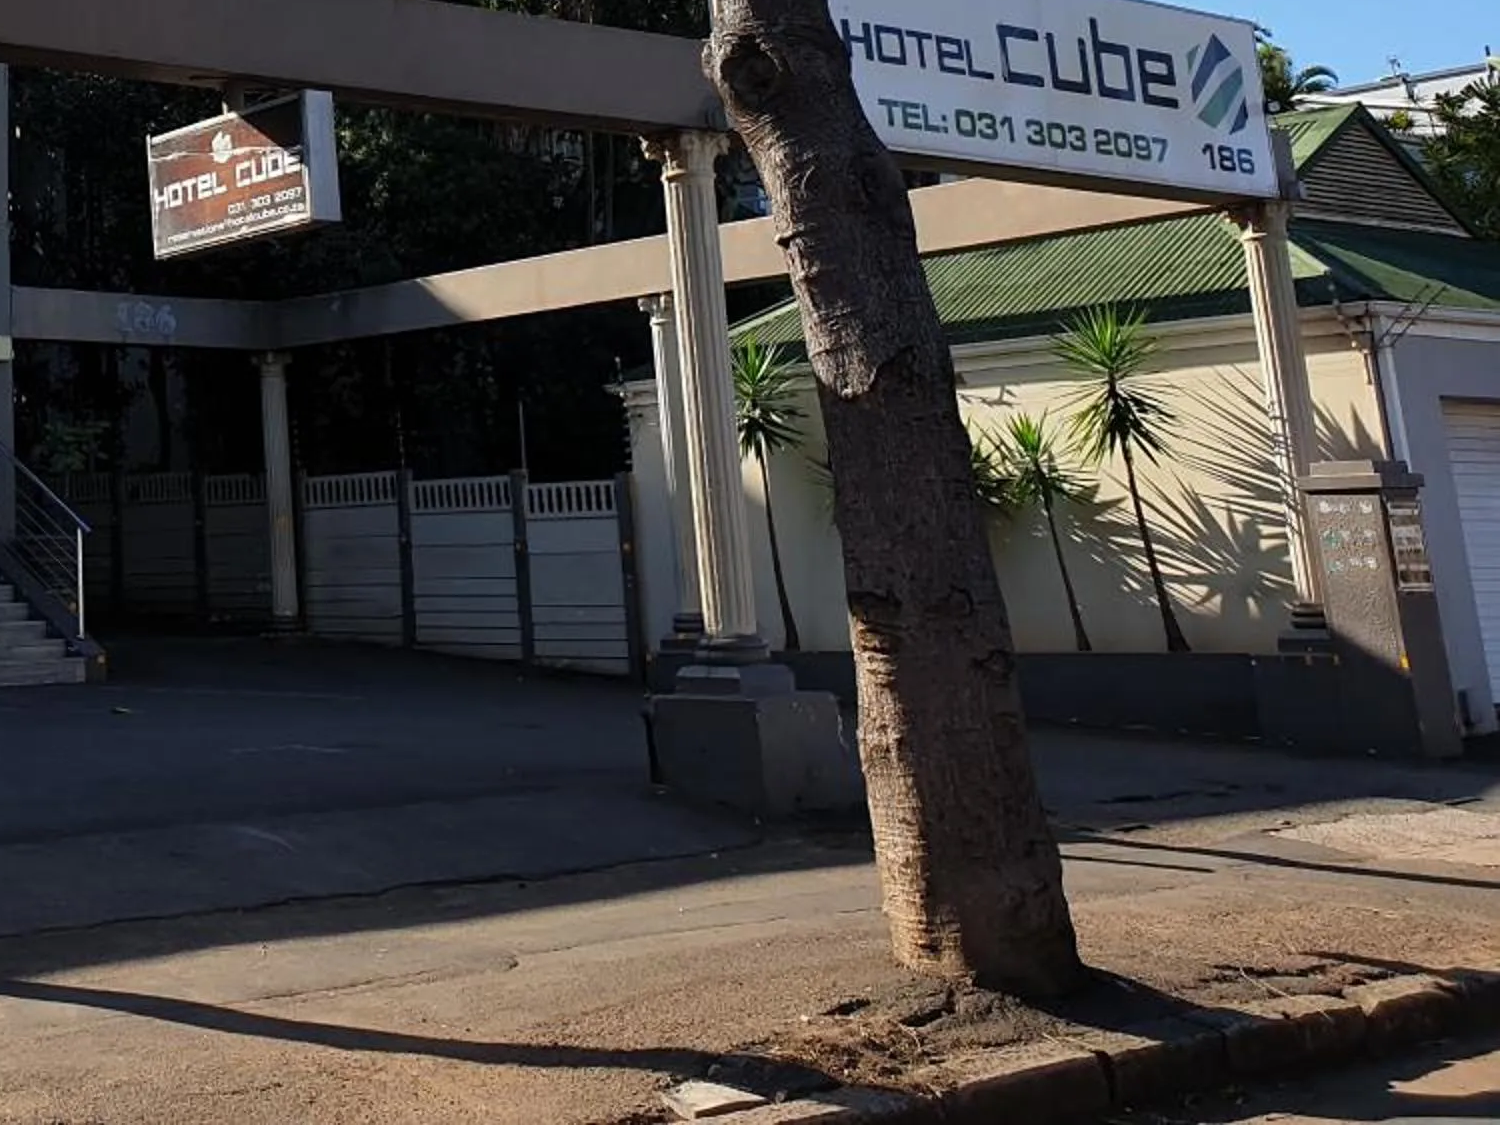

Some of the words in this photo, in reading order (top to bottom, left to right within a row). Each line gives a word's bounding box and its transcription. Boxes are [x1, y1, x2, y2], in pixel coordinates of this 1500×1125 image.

[878, 98, 949, 134] TEL:
[955, 109, 1016, 144] 031
[1026, 118, 1087, 153] 303
[1095, 128, 1169, 164] 2097
[1202, 142, 1256, 175] 186
[154, 171, 228, 211] HOTEL
